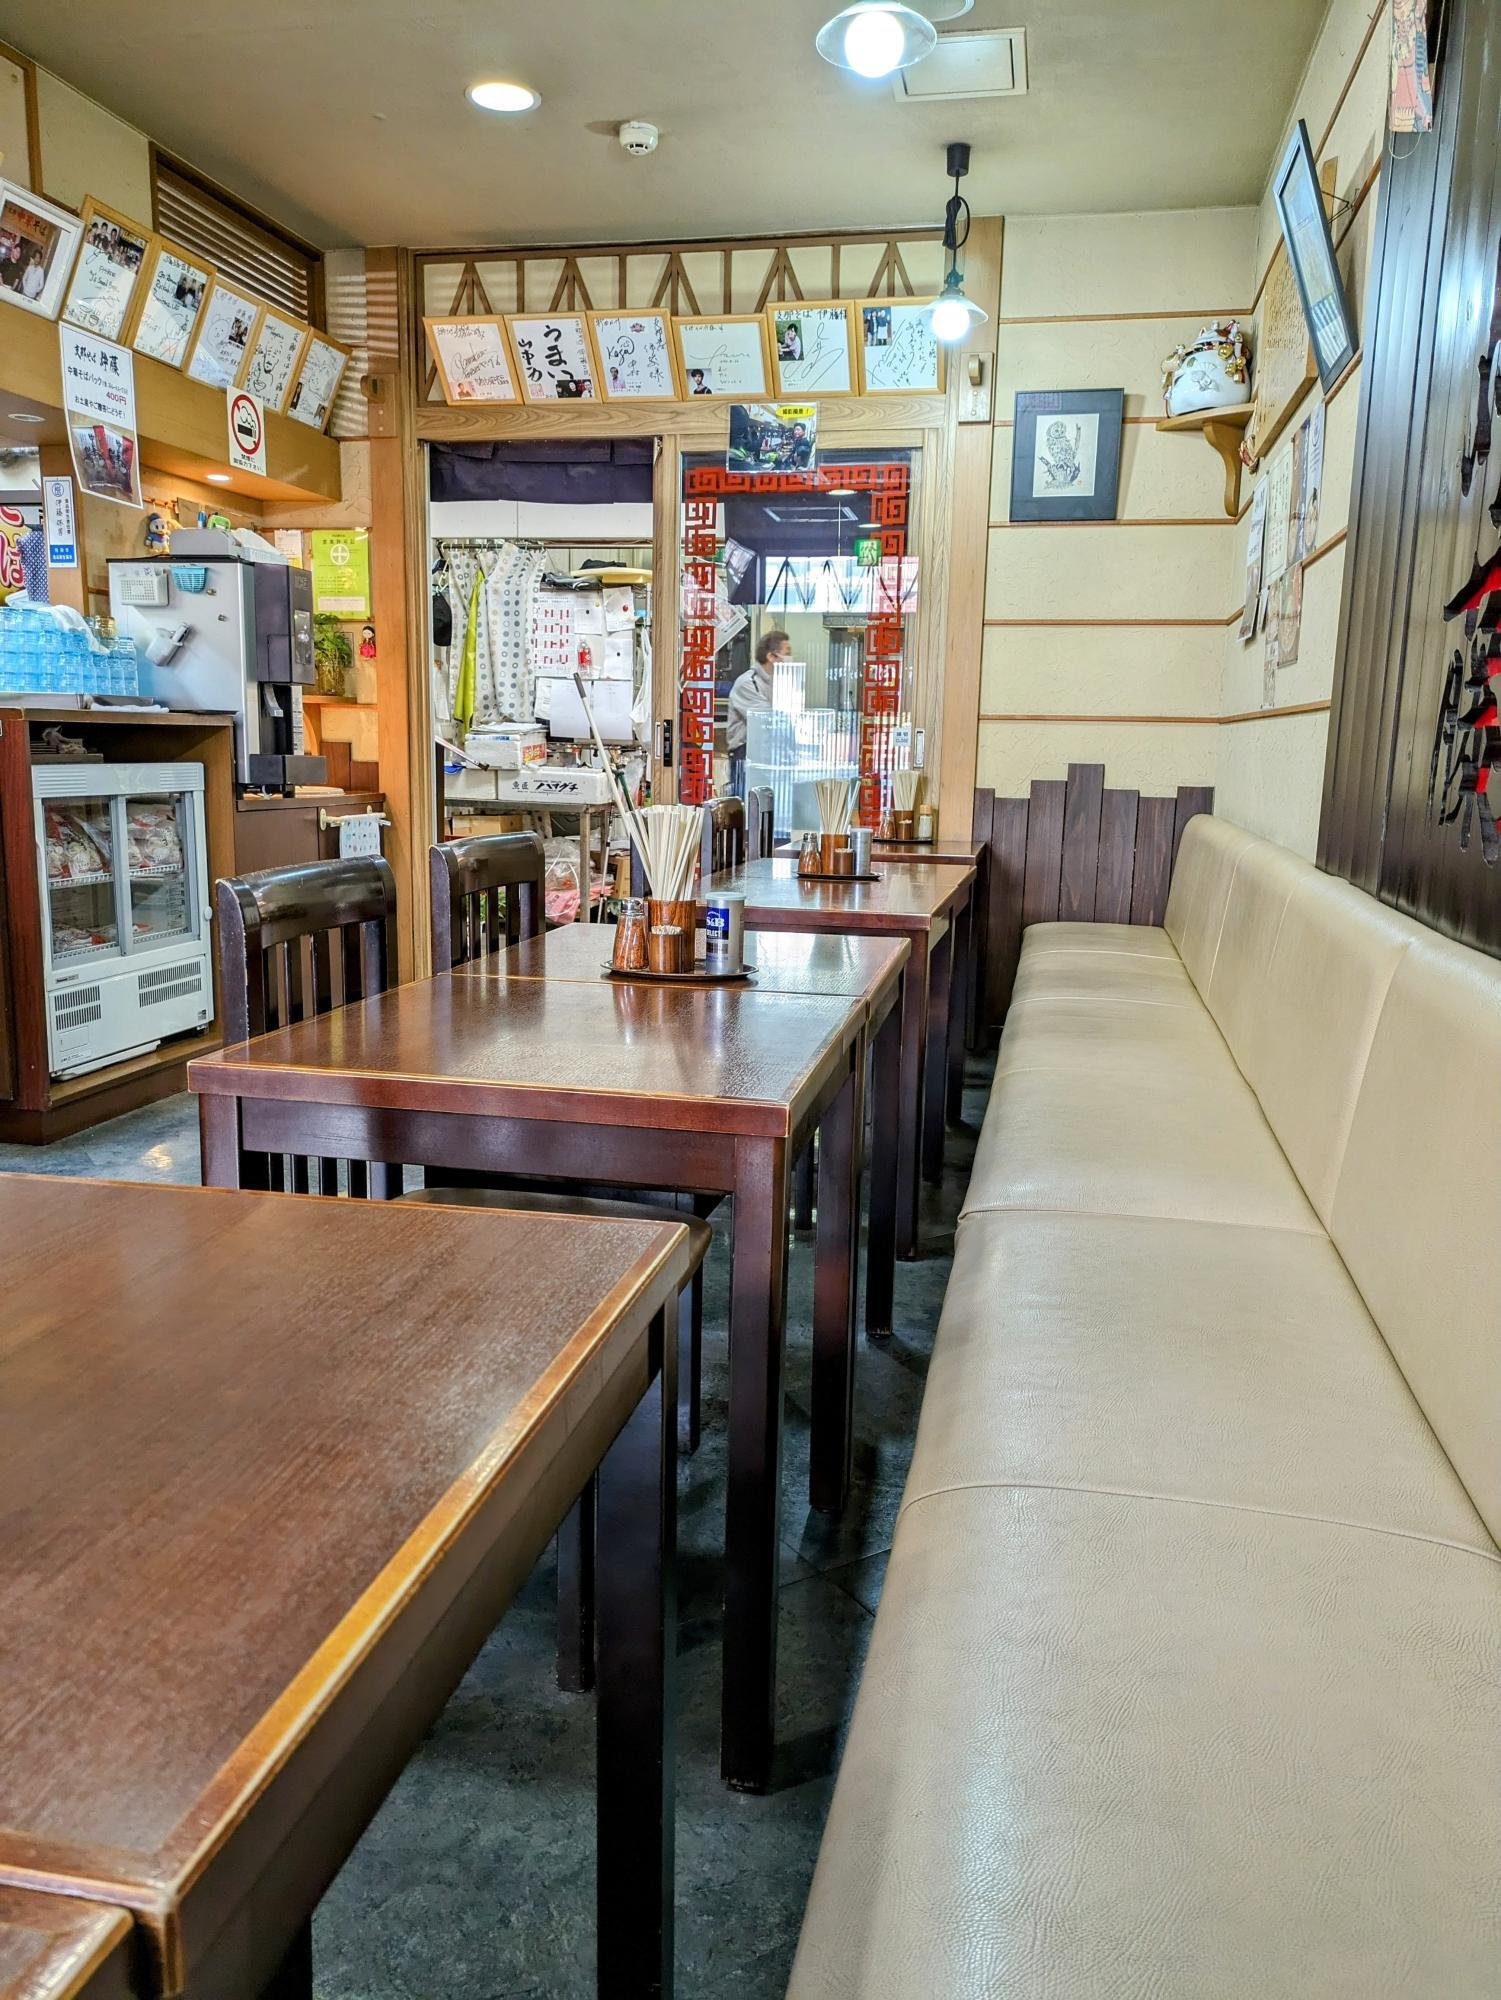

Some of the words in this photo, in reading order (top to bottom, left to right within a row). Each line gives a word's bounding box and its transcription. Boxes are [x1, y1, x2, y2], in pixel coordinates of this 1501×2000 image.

[543, 324, 574, 379] うまい
[106, 391, 127, 406] 400円
[706, 916, 725, 927] S&B
